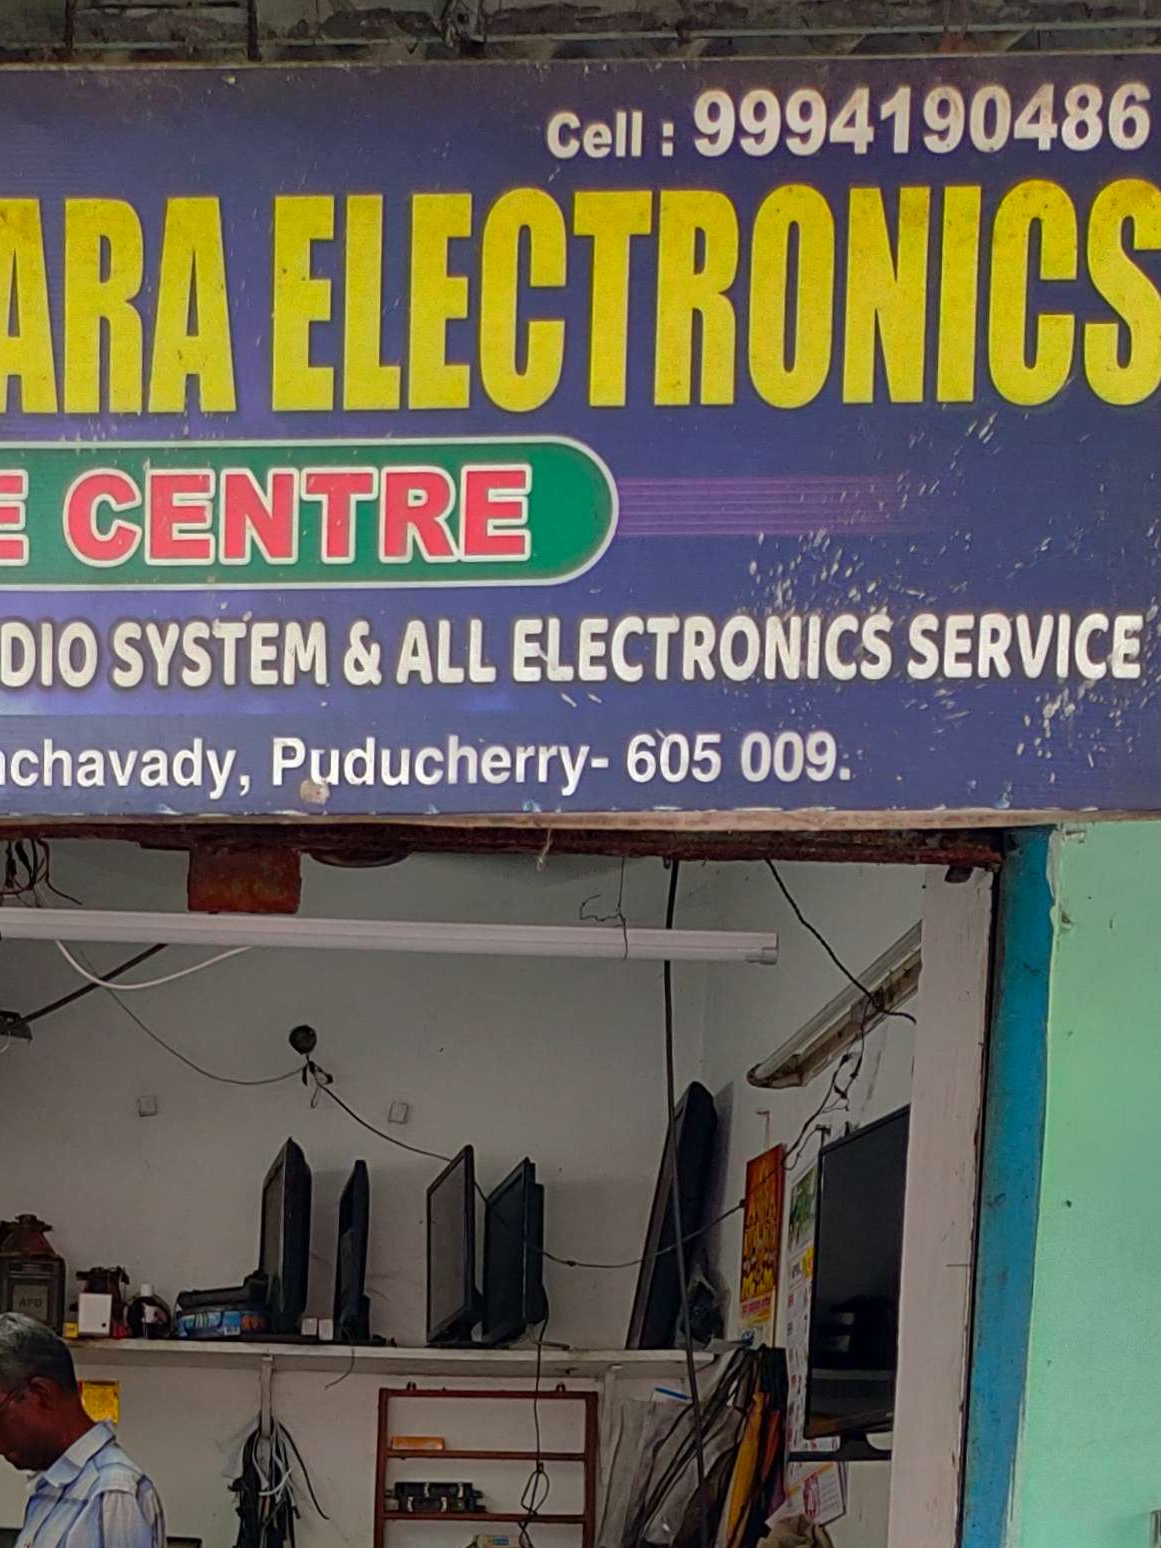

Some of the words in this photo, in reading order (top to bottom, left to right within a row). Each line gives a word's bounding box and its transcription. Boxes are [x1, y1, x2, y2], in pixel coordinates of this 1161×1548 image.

[547, 110, 642, 160] Cell
[693, 82, 1152, 159] 9994190486
[272, 179, 1161, 413] ELECTRONICS
[63, 464, 532, 567] CENTRE
[113, 617, 327, 688] SYSTEM
[344, 618, 382, 687] &
[396, 616, 498, 685] ALL
[511, 615, 891, 684] ELECTRONICS
[906, 613, 1143, 681] SERVICE
[272, 736, 610, 797] Puducherry-
[626, 733, 722, 783] 605
[741, 731, 851, 782] 009.
